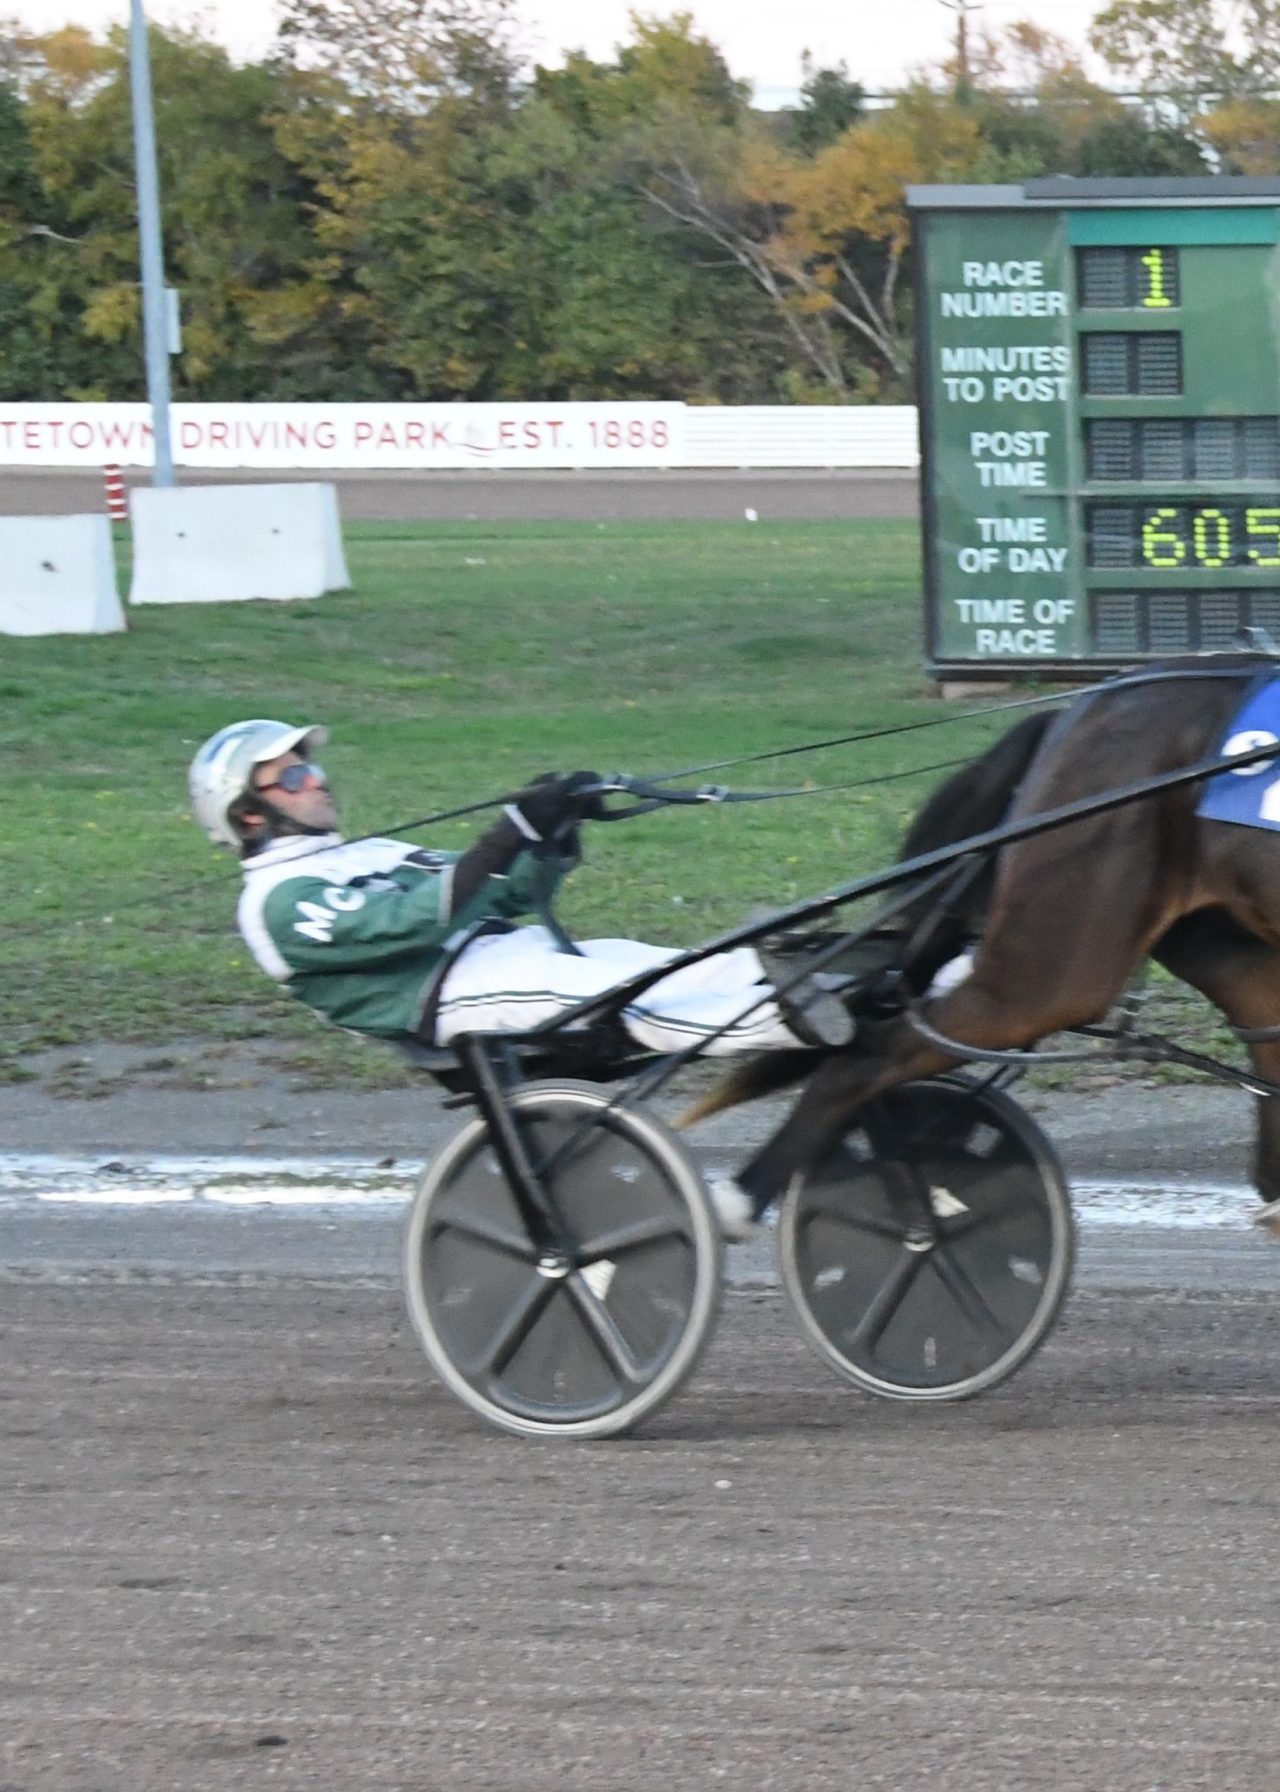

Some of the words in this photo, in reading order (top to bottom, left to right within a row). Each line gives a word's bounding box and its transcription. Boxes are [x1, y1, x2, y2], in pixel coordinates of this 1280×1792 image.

[963, 260, 1044, 287] RACE
[1142, 248, 1171, 307] 1
[941, 291, 1069, 318] NUMBER
[941, 345, 1072, 373] MINUTES
[943, 376, 985, 403] TO
[993, 376, 1072, 402] POST
[181, 420, 337, 449] DRIVING
[354, 420, 452, 449] PARK
[588, 419, 669, 449] 1888
[970, 431, 1050, 458] POST
[974, 461, 1047, 487] TIME
[975, 517, 1047, 542] TIME
[957, 547, 1000, 573] OF
[1009, 547, 1068, 573] DAY
[954, 598, 1026, 624] TIME
[1033, 599, 1075, 625] OF
[976, 628, 1057, 655] RACE
